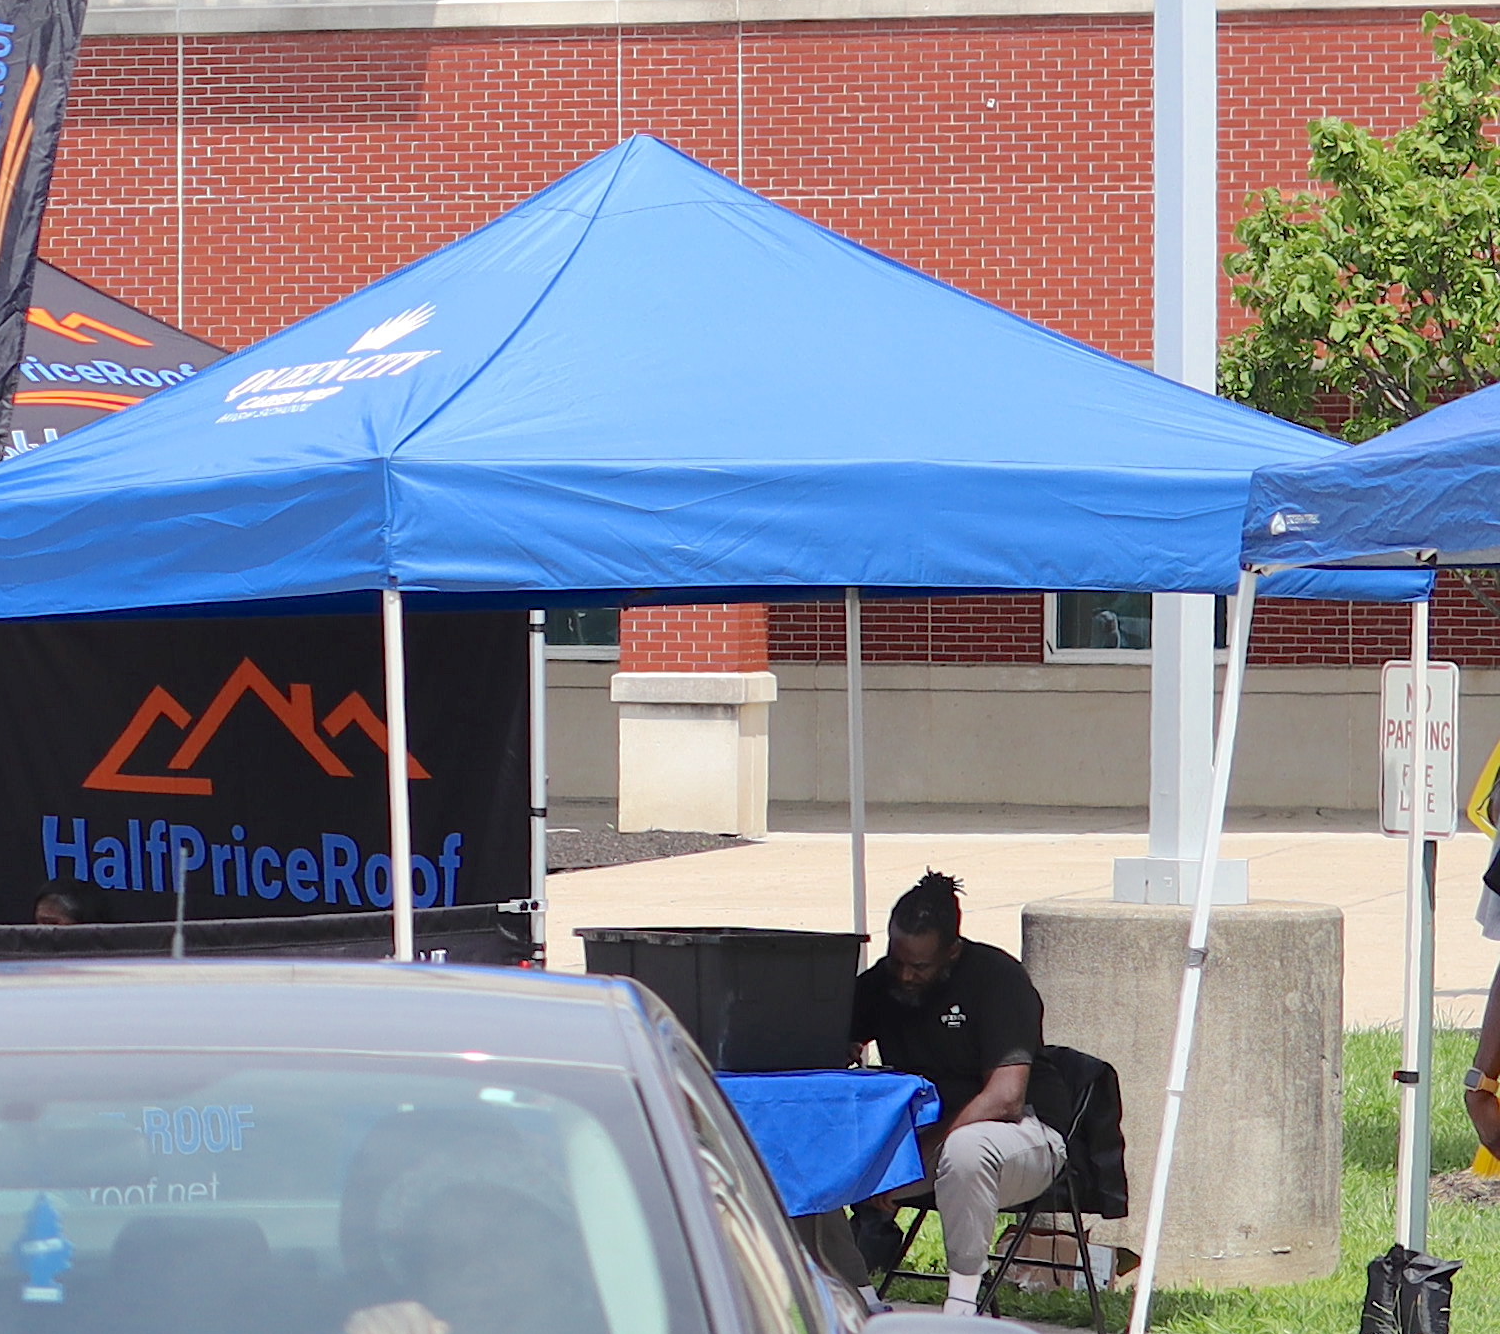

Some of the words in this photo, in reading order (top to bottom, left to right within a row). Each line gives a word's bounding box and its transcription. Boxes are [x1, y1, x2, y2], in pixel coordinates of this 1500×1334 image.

[1386, 719, 1451, 751] PARING
[1403, 764, 1433, 787] FE
[1400, 791, 1436, 813] LE
[41, 815, 463, 909] HalfPriceRoof
